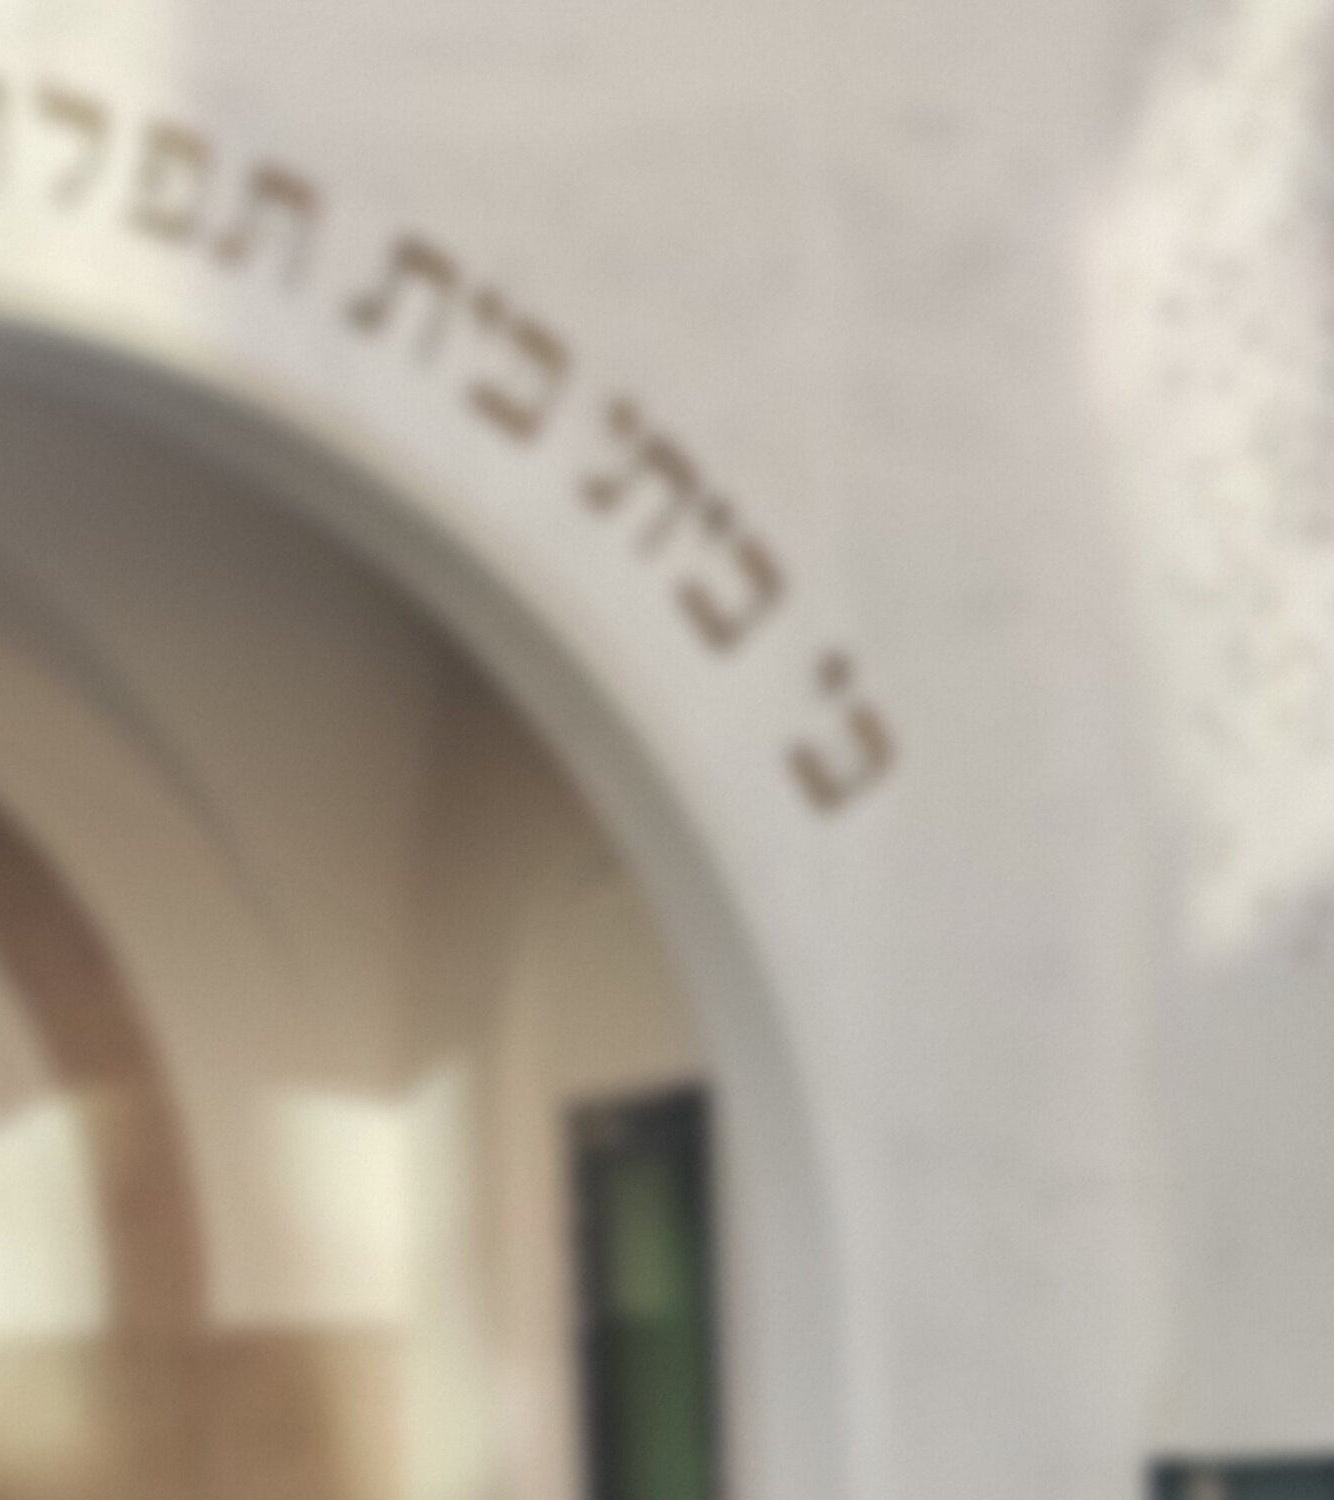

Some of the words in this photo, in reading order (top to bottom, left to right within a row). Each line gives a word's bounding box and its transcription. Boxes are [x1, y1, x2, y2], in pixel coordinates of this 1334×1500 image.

[341, 230, 571, 444] בית
[575, 394, 785, 656] ביתי
[784, 646, 899, 814] כי
